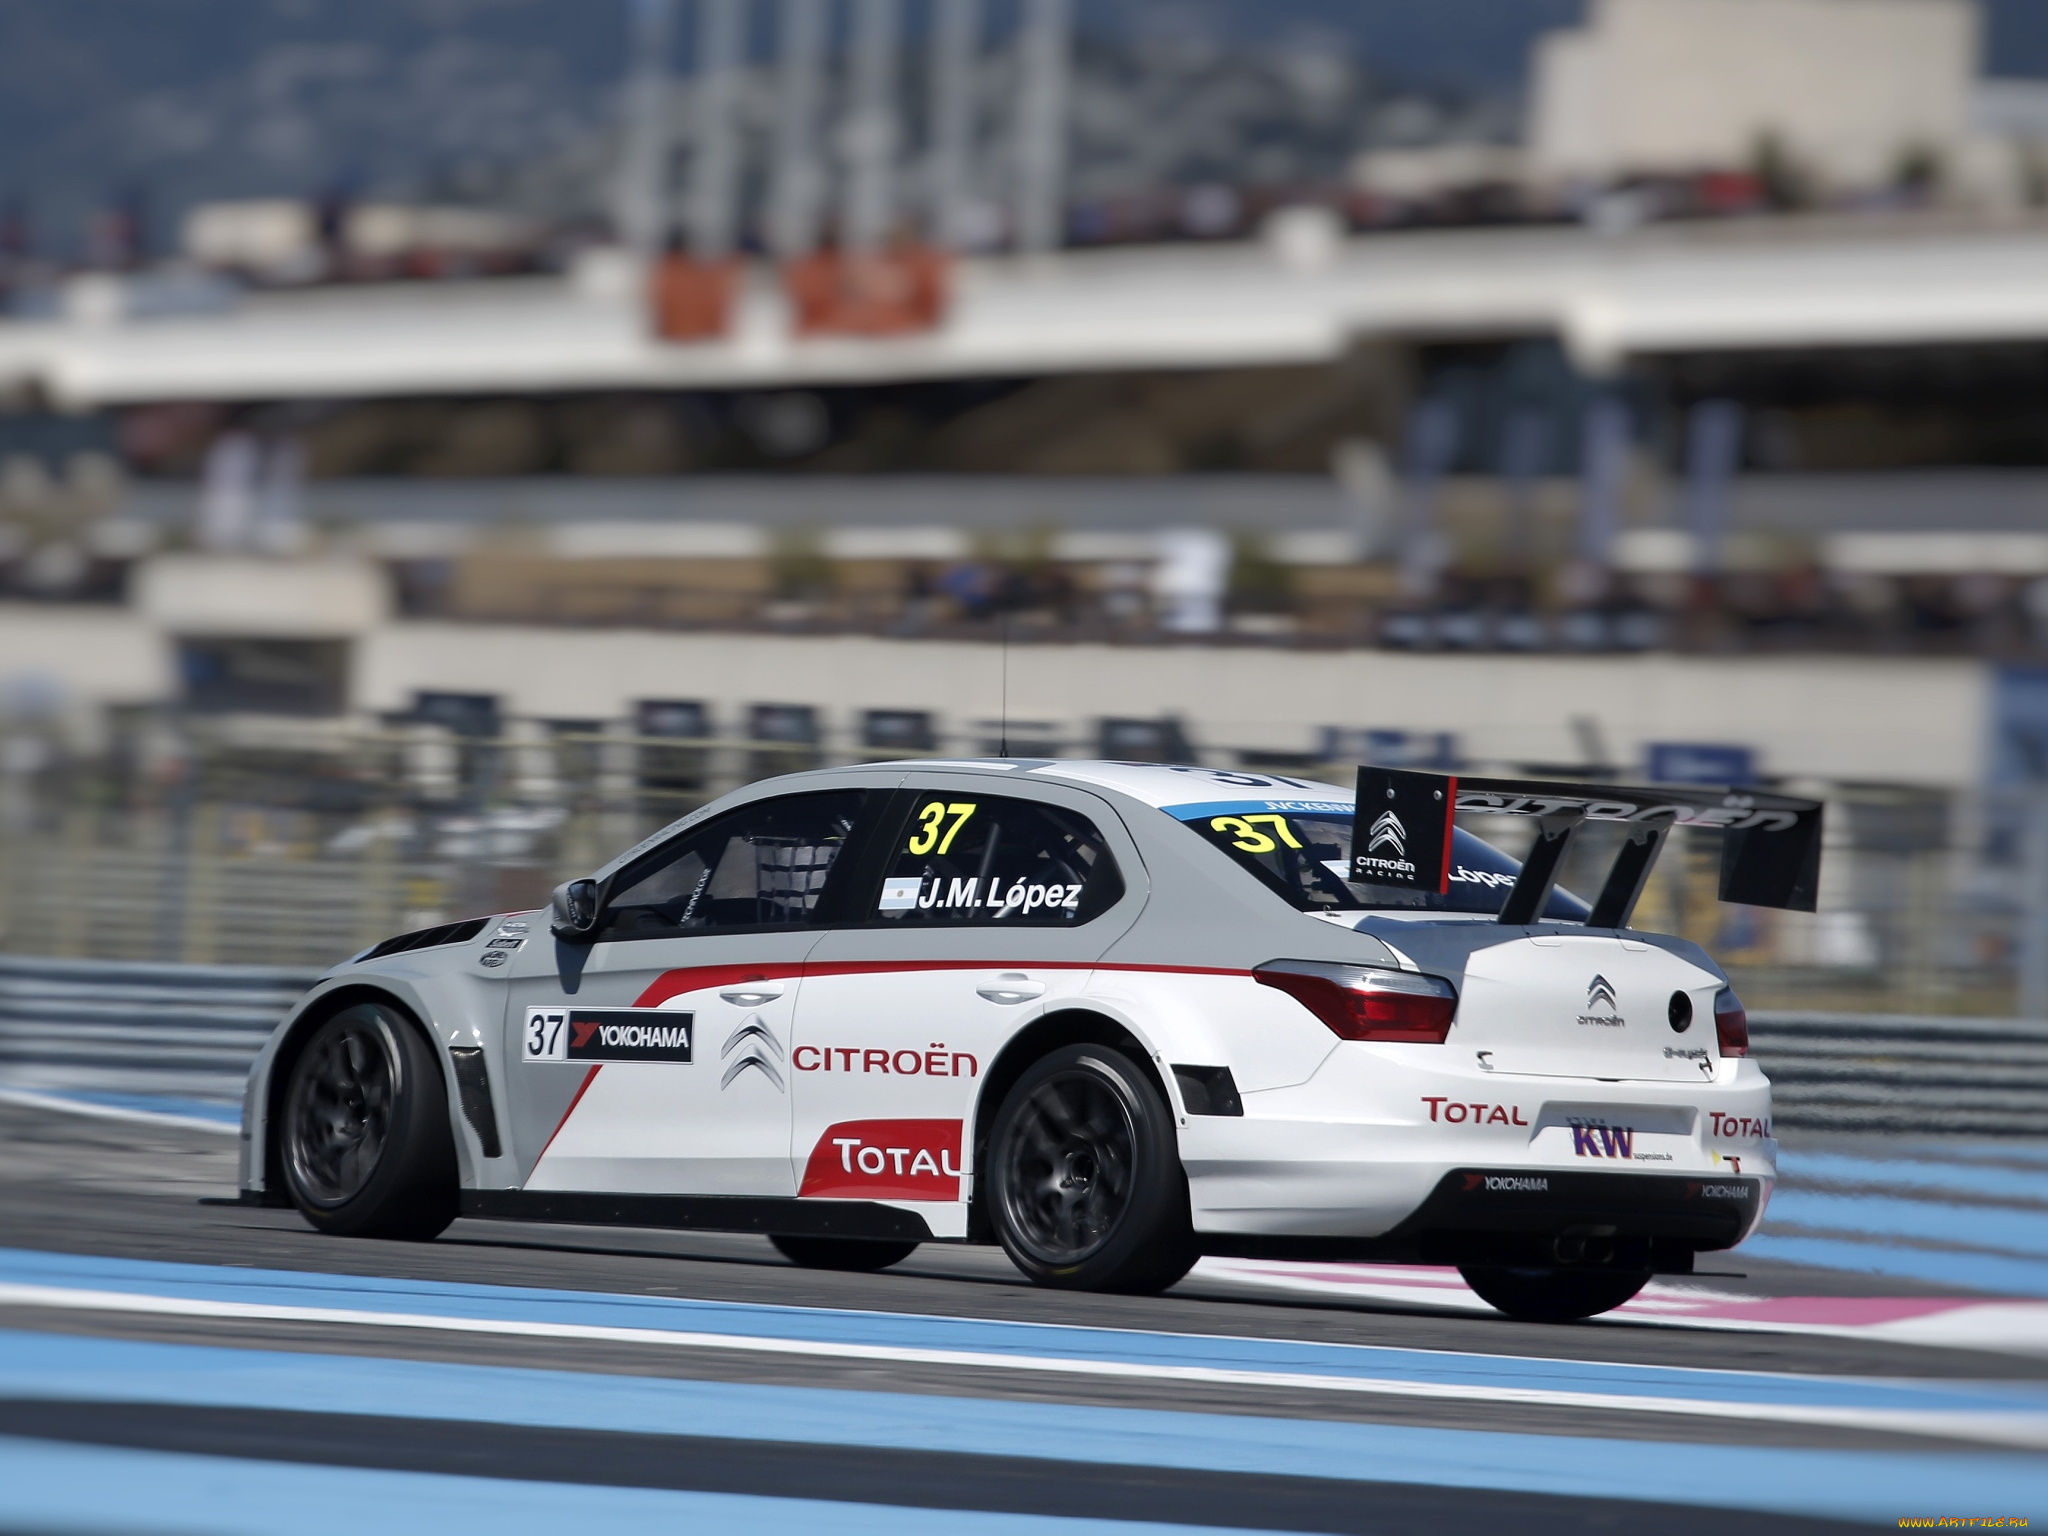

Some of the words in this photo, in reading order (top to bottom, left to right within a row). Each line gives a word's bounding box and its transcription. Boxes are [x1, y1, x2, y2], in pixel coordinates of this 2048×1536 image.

[909, 802, 977, 855] 37
[1210, 814, 1303, 853] 37
[1356, 856, 1416, 873] CITROËN
[918, 877, 982, 909] J.M.
[986, 876, 1083, 914] López
[527, 1014, 564, 1056] 37
[599, 1025, 689, 1048] YOKOHAMA
[792, 1042, 978, 1077] CITROËN
[1421, 1096, 1528, 1126] TOTAL
[1709, 1111, 1771, 1139] TOTAL
[832, 1138, 961, 1177] TOTAL
[1571, 1123, 1634, 1160] KW
[1485, 1176, 1549, 1192] YOKOHAMA
[1702, 1184, 1749, 1199] YOKOHAMA
